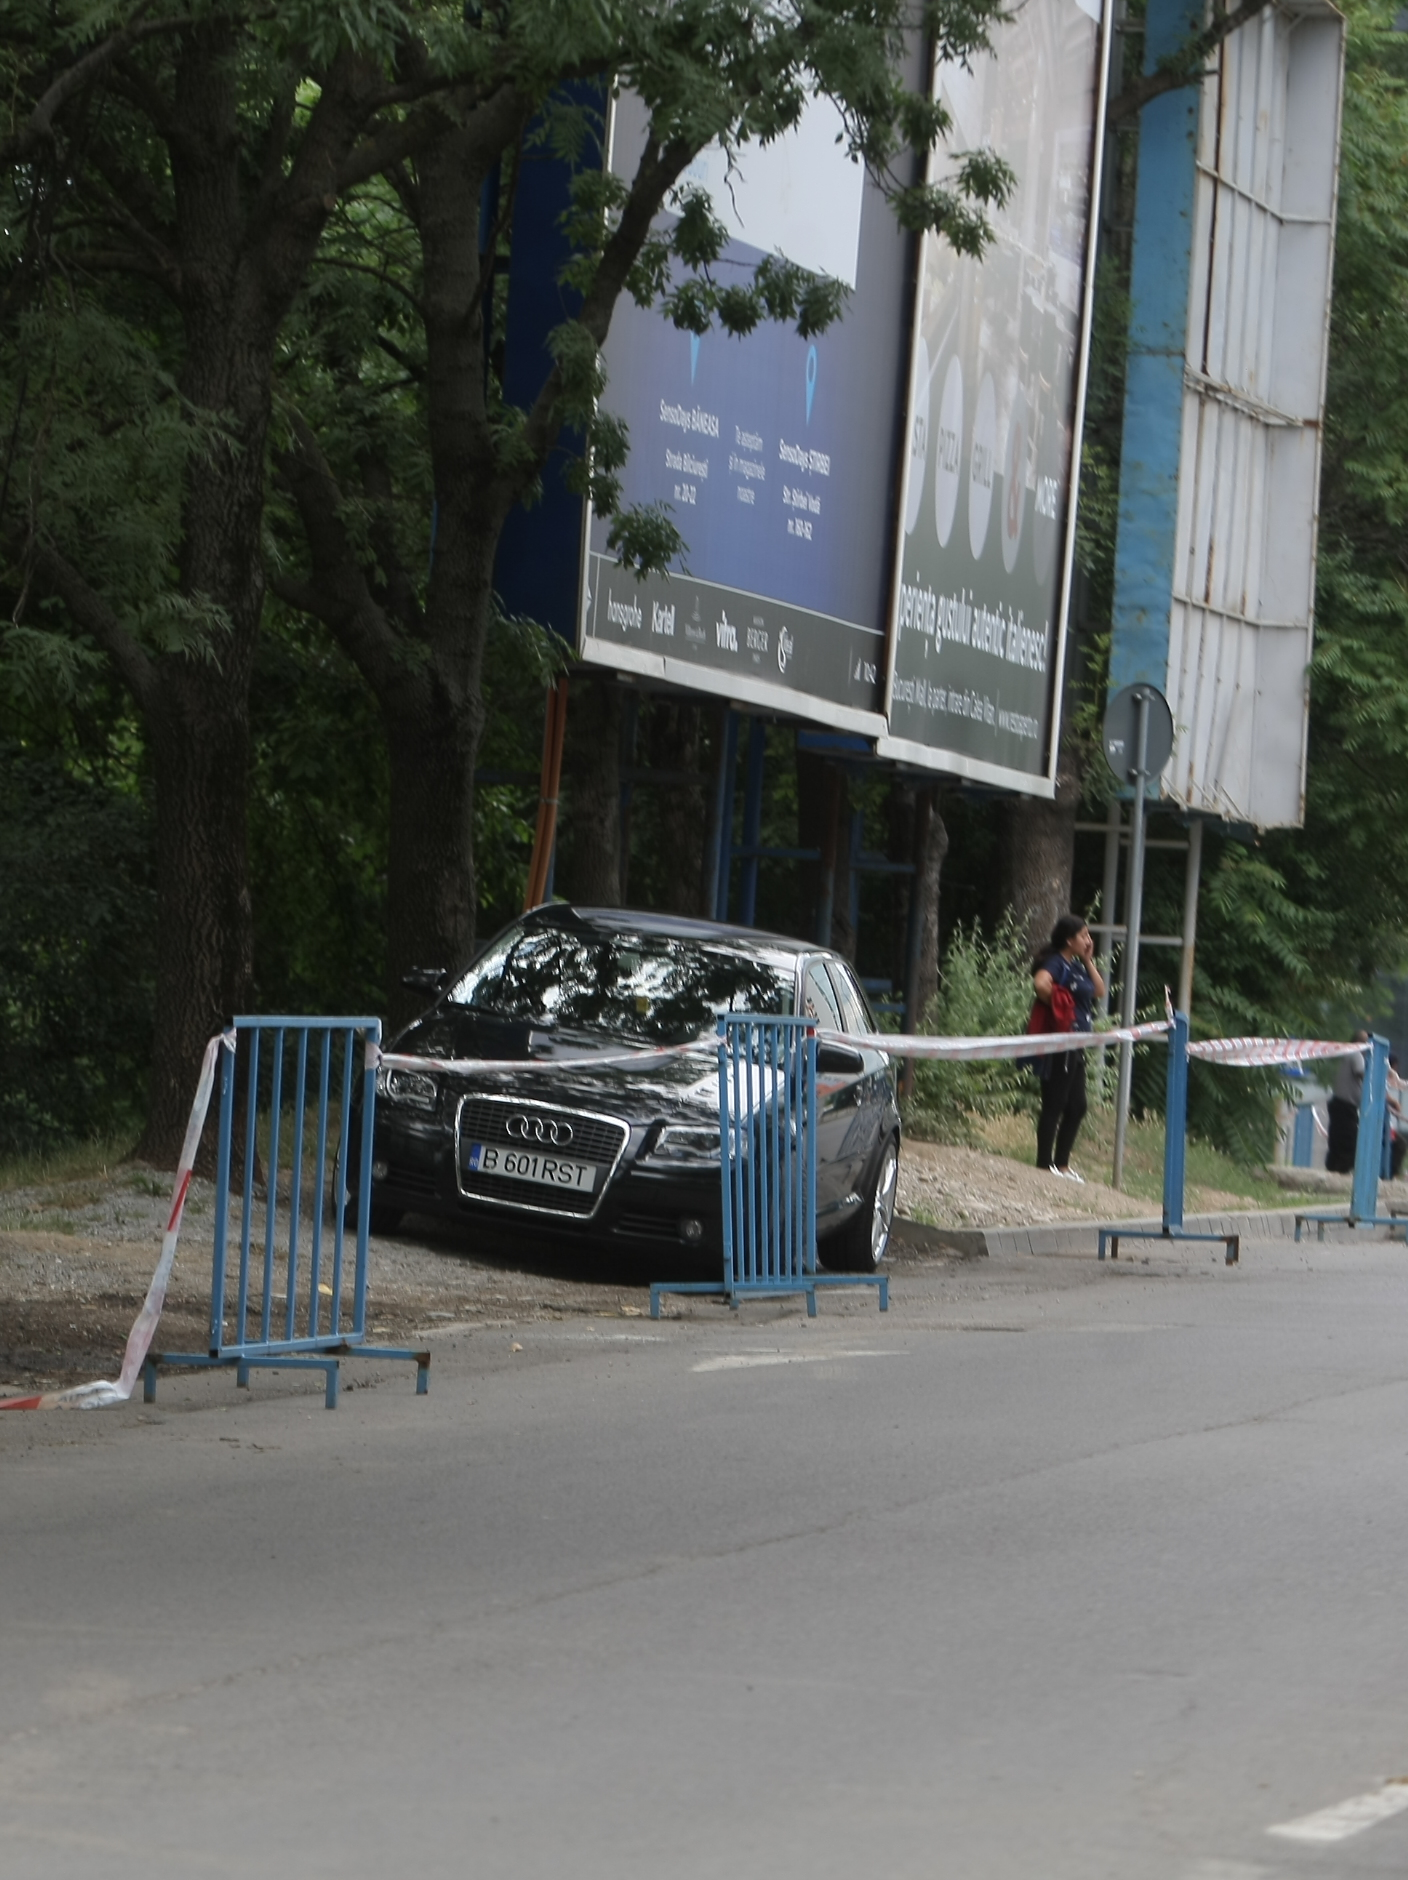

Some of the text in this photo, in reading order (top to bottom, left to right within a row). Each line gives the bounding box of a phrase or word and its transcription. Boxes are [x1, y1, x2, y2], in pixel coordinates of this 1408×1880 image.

[607, 587, 642, 632] hansgrohe
[651, 600, 675, 637] Kartell
[935, 586, 972, 654] gustului
[971, 601, 1007, 659] autentic
[482, 1147, 499, 1170] B
[504, 1151, 538, 1178] 601
[541, 1159, 588, 1187] RST
